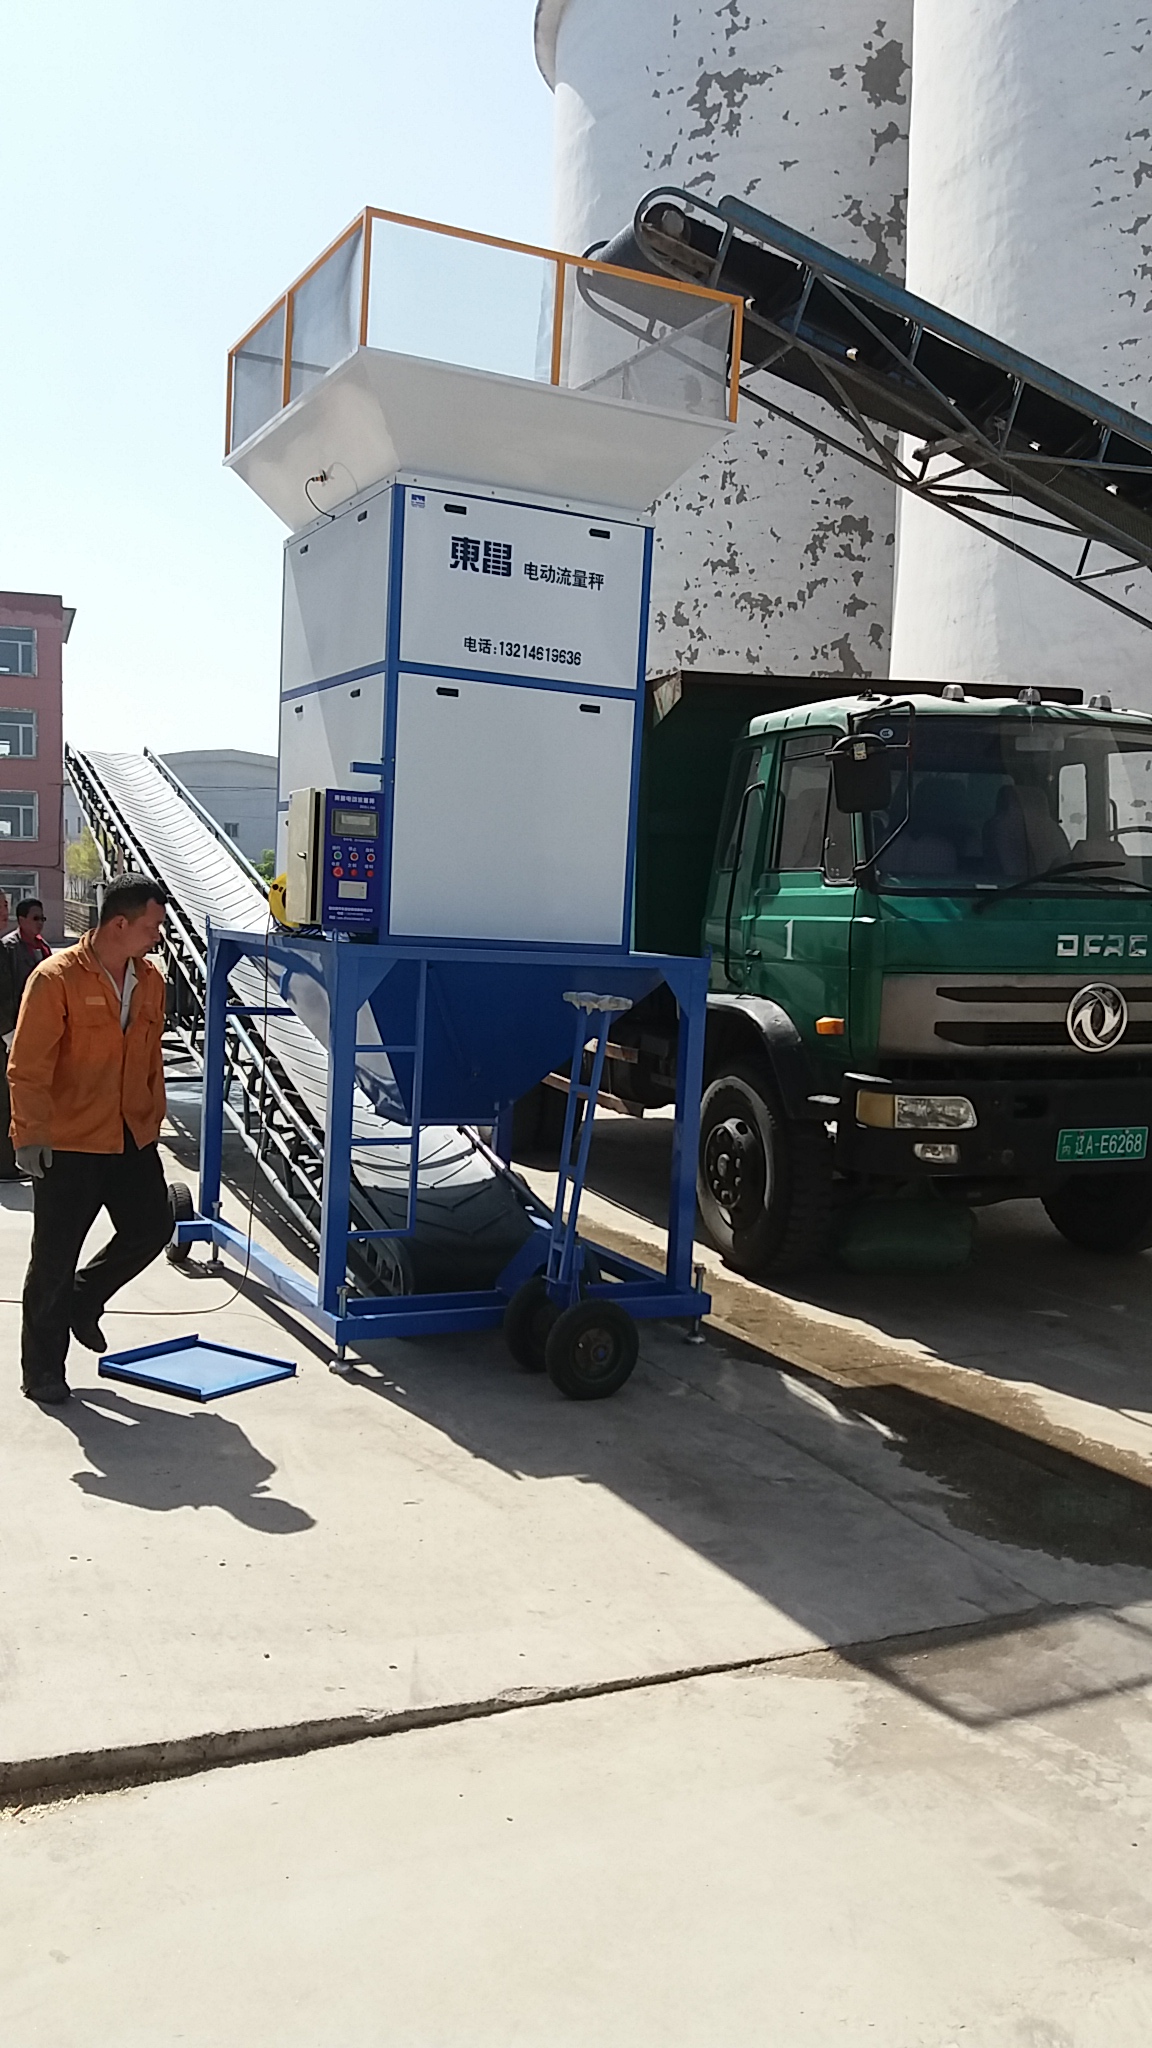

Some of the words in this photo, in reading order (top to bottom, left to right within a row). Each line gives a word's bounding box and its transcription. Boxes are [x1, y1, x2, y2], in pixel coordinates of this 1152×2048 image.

[523, 561, 605, 591] 电动流量秤
[783, 919, 794, 960] 1
[1057, 934, 1148, 957] DFAC
